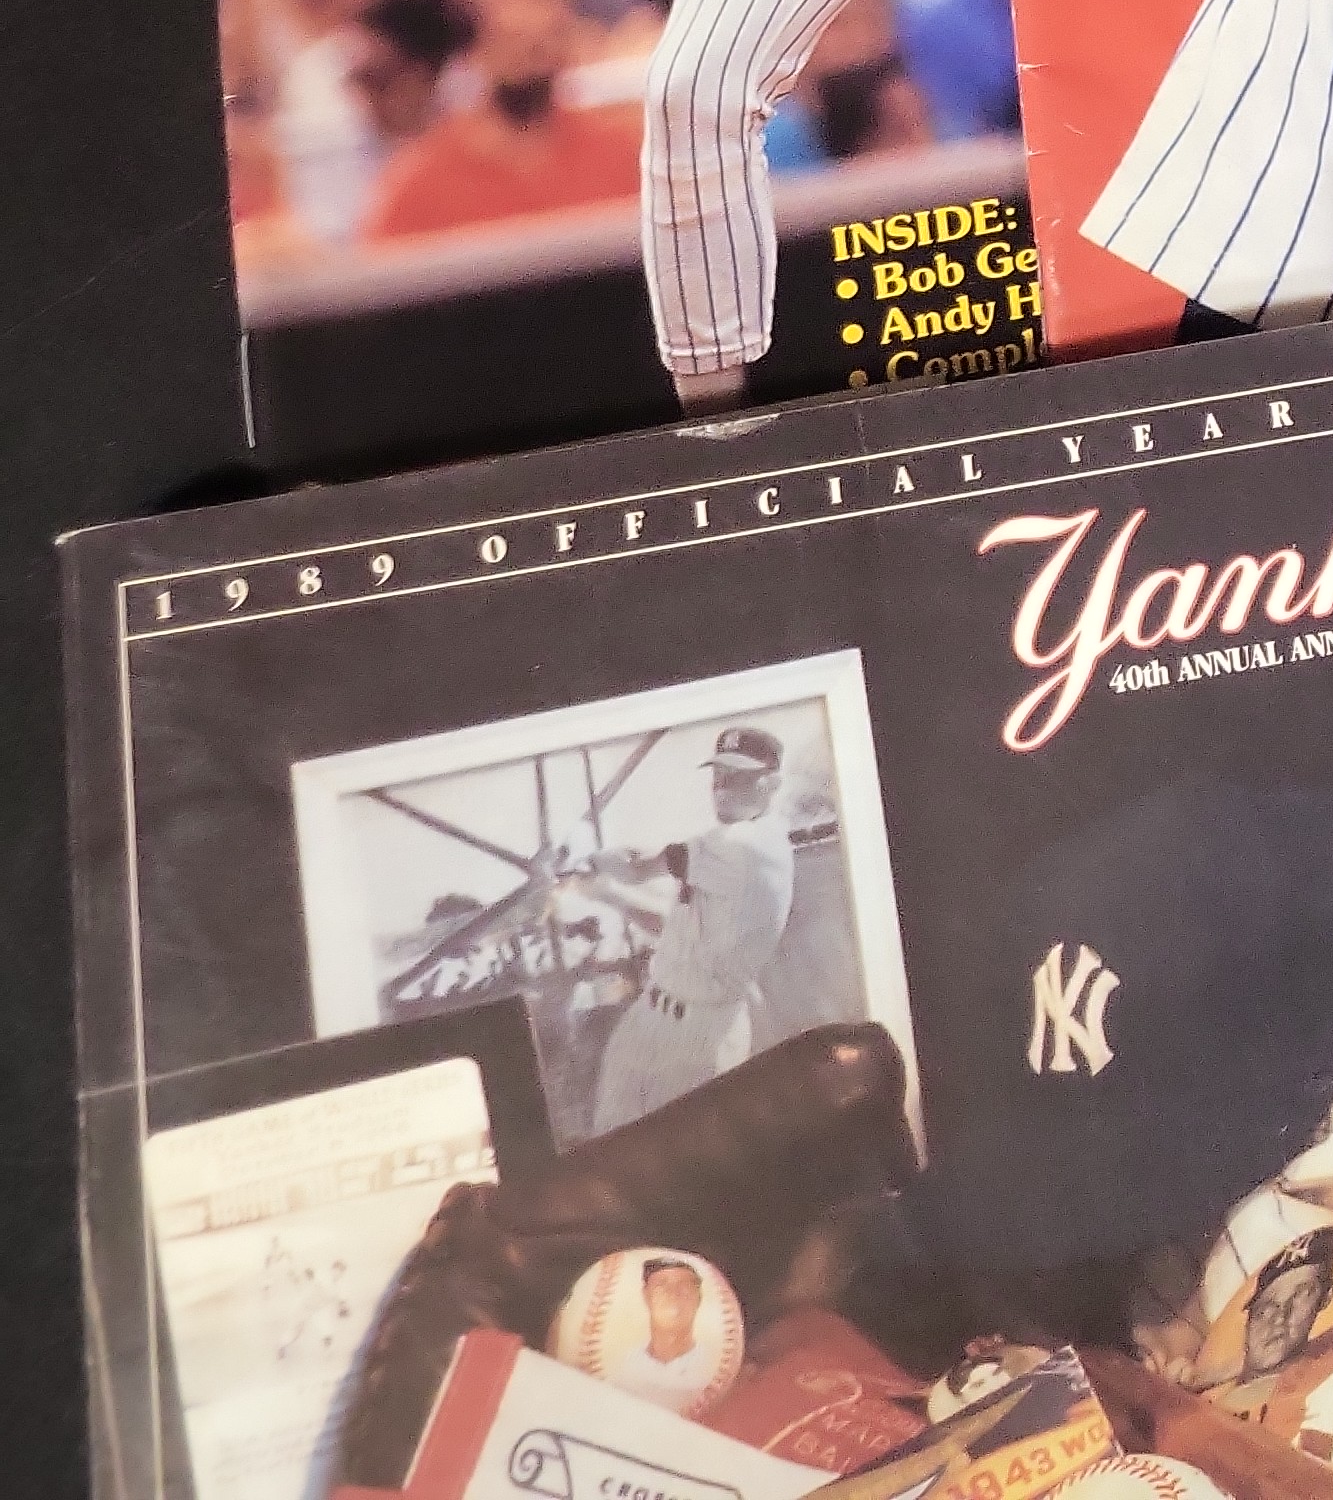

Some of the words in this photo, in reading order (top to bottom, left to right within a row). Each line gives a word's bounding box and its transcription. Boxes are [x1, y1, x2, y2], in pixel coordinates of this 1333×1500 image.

[831, 198, 1018, 262] INSIDE:
[873, 253, 966, 301] Bob
[976, 241, 1038, 279] Ge
[879, 295, 997, 346] Andy
[154, 553, 396, 621] 1989
[480, 454, 983, 566] OFFICIAL
[1108, 658, 1171, 694] 40th
[1177, 641, 1285, 683] ANNUAL
[1027, 942, 1120, 1077] NY
